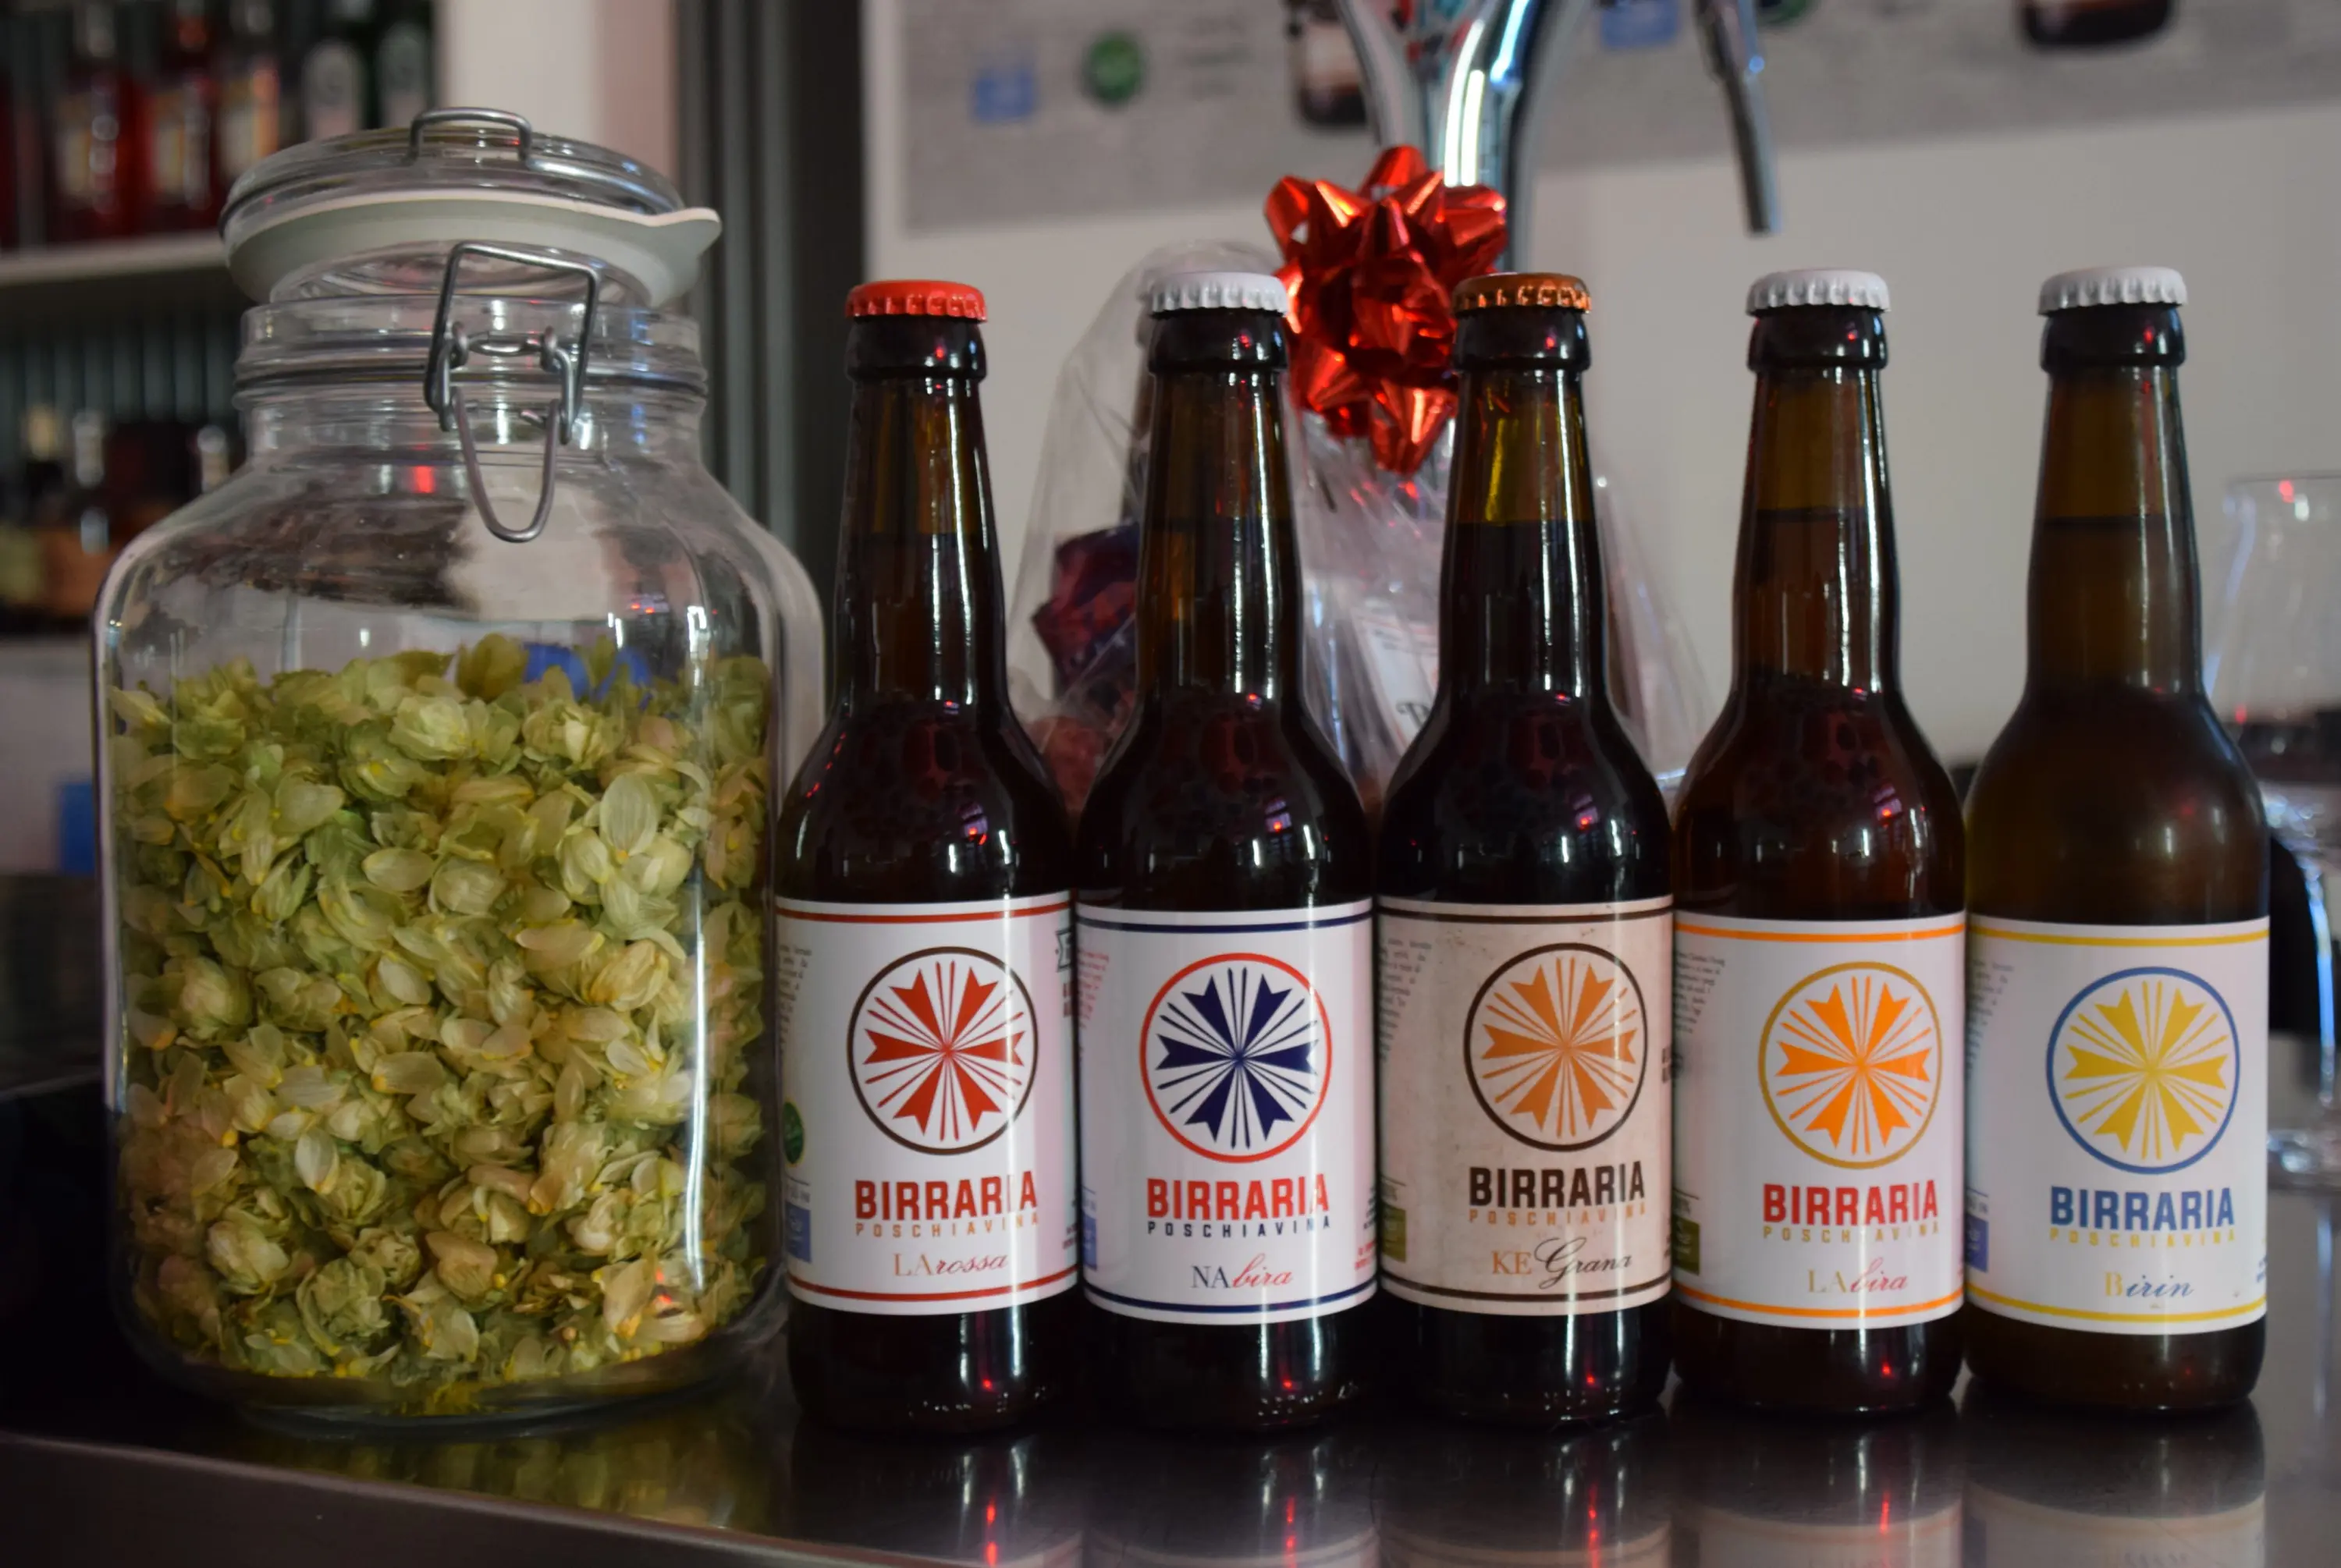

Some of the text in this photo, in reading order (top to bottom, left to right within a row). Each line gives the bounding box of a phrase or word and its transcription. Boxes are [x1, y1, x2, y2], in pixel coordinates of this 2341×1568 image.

[1147, 1173, 1330, 1221] BIRRARIA
[1469, 1160, 1645, 1208] BIRRARIA
[1763, 1180, 1938, 1226] BIRRARIA
[2050, 1186, 2235, 1231] BIRRARIA
[855, 1212, 1039, 1238] POSCHIAVINA
[1148, 1215, 1330, 1238] POSCHIAVINA
[1763, 1220, 1939, 1243] POSCHAVINA
[2049, 1228, 2236, 1248] POSCHIAVINA
[2105, 1272, 2195, 1297] Birin
